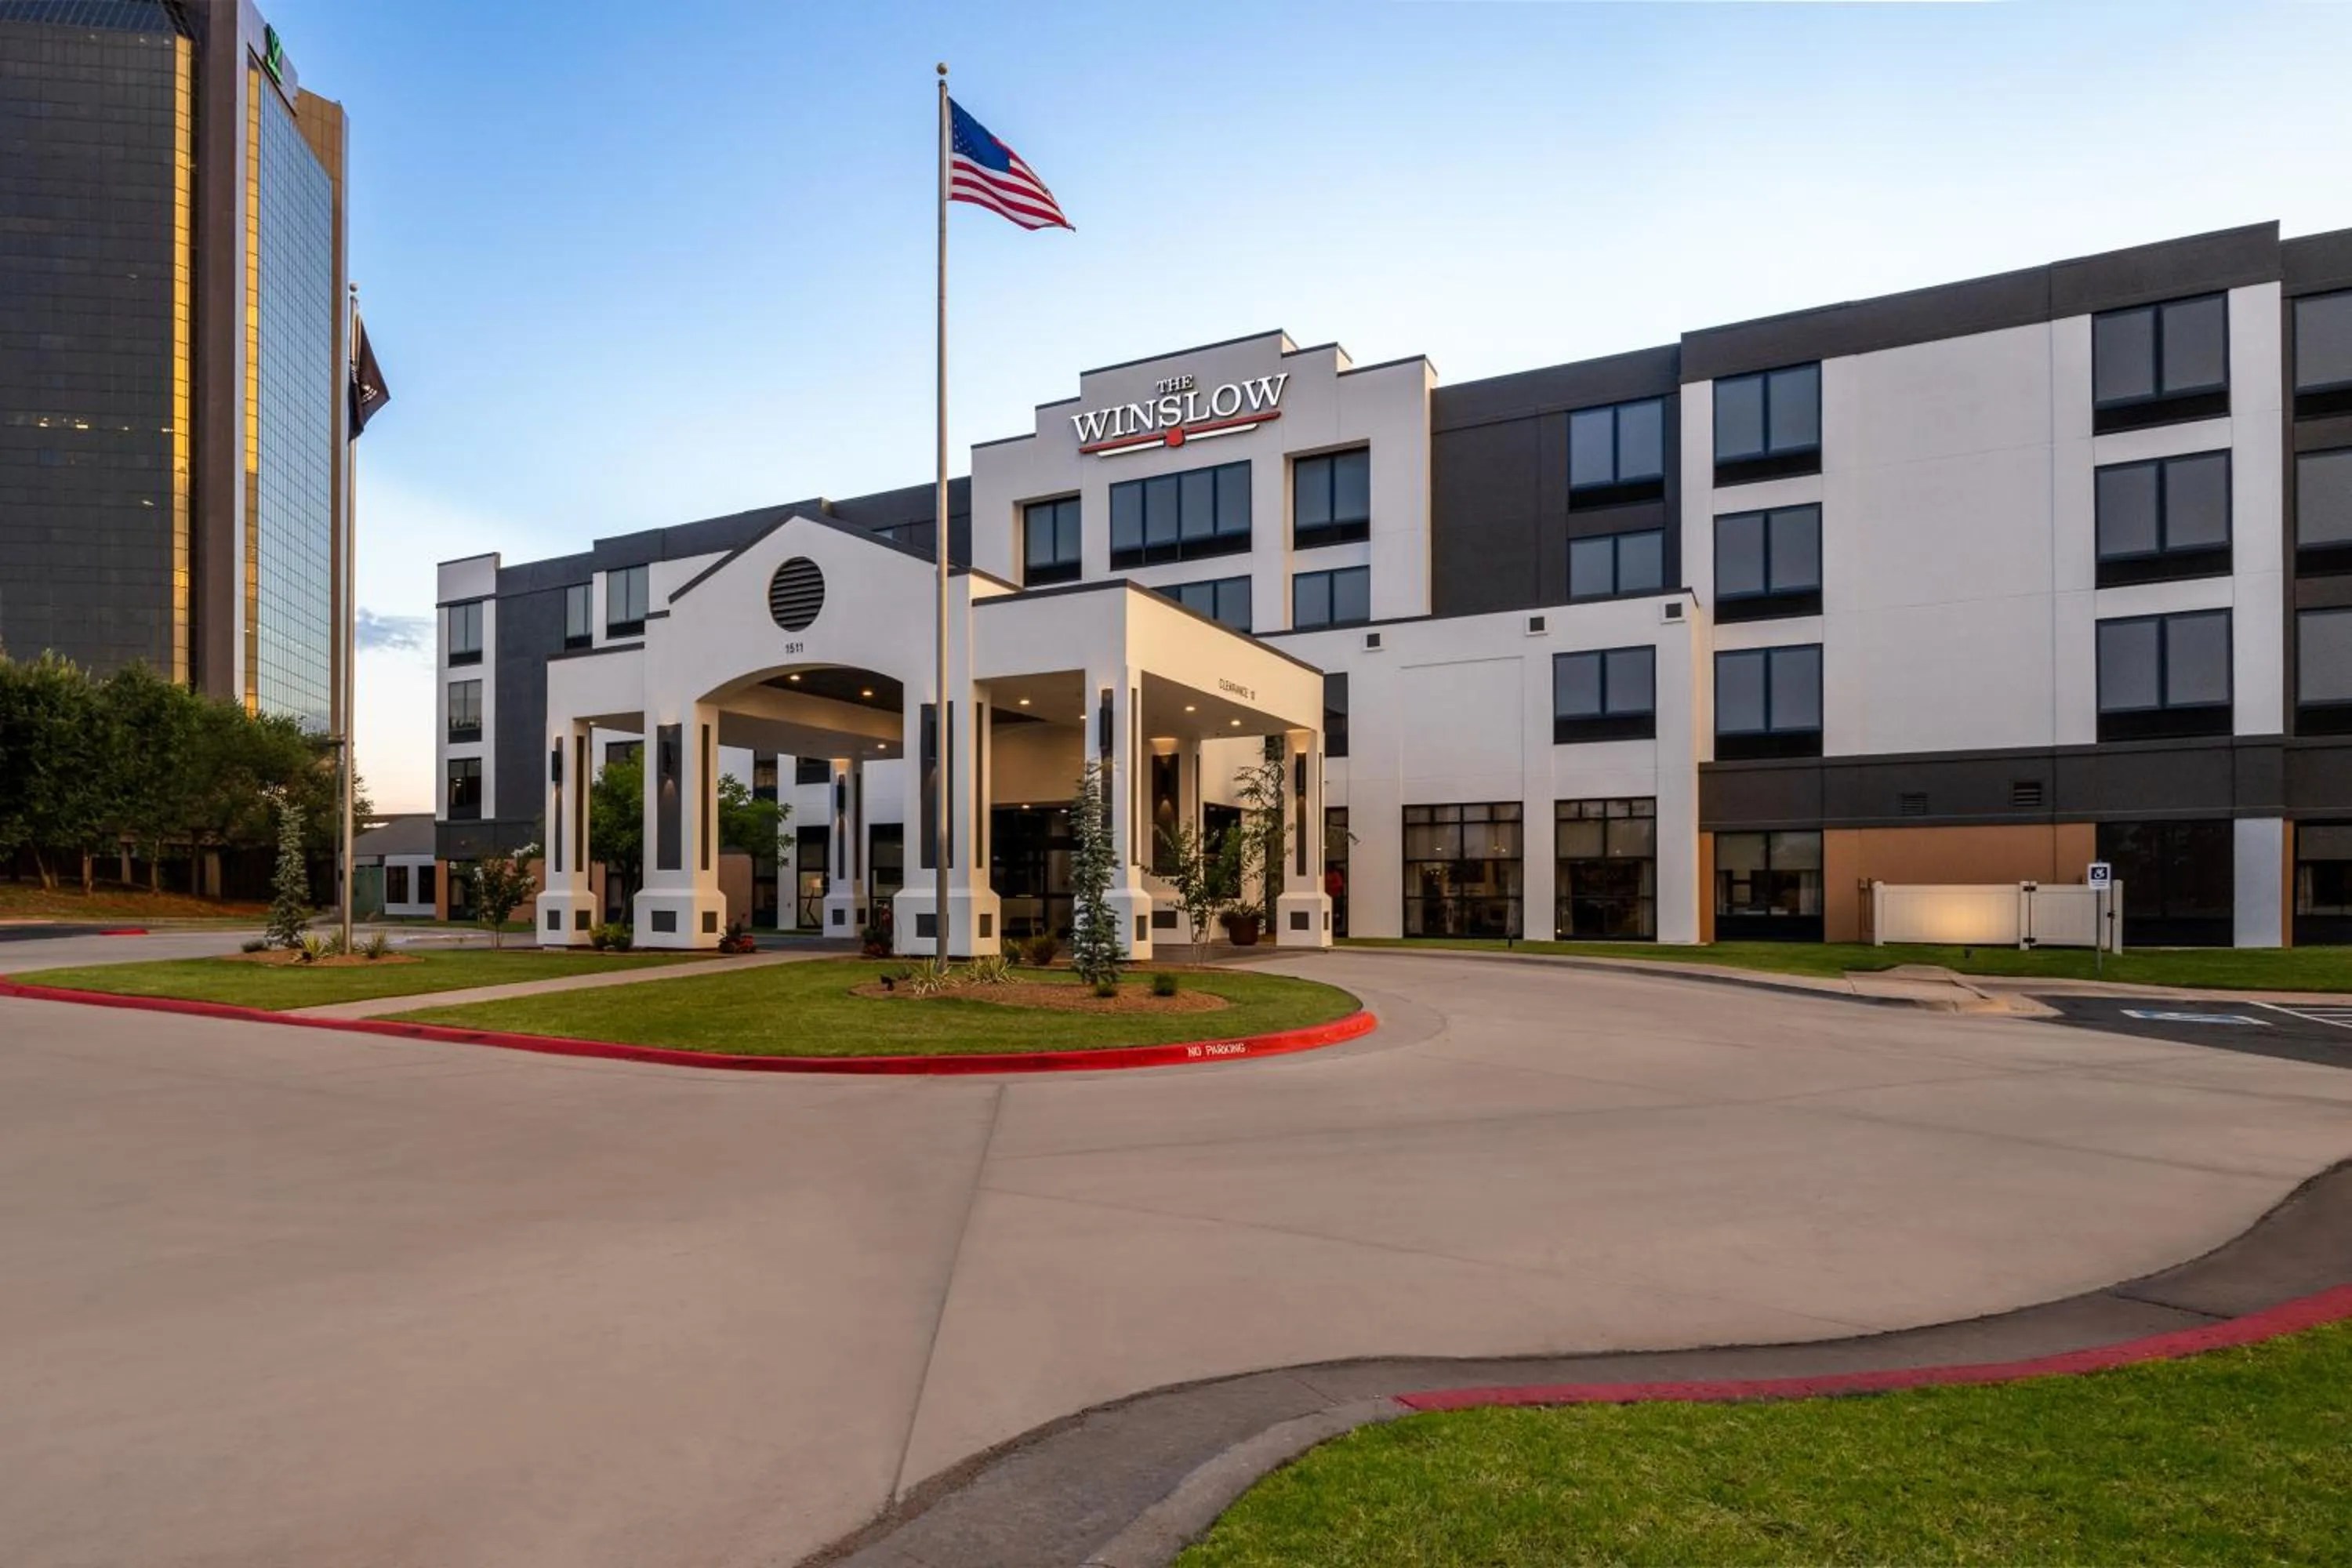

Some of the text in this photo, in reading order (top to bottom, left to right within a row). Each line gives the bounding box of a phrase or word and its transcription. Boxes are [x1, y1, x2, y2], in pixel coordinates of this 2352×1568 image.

[1156, 374, 1193, 393] THE
[1070, 372, 1289, 443] WINSLOW
[786, 642, 804, 653] 1511
[1187, 1043, 1246, 1058] NO PARKING
